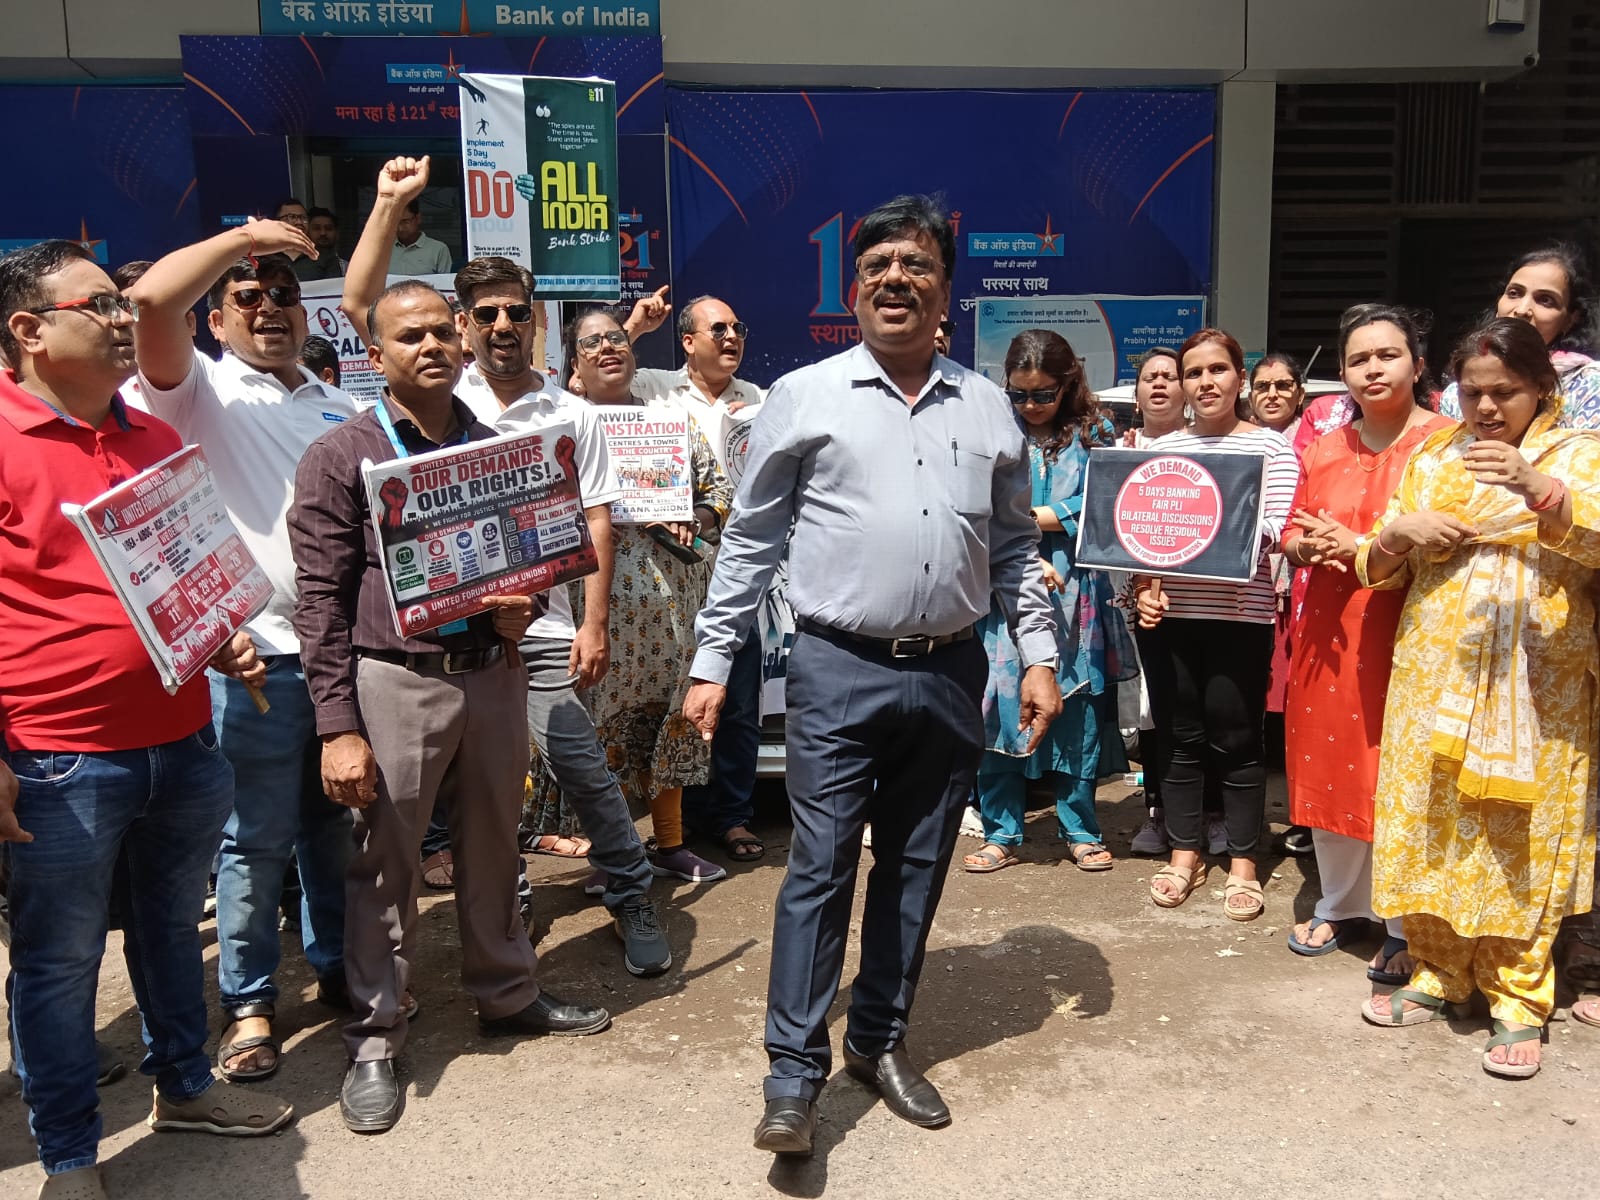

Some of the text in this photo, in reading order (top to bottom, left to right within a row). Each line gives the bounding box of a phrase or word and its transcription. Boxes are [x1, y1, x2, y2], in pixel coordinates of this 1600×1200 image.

[495, 4, 650, 27] Bank of India
[335, 105, 359, 120] मना
[361, 105, 383, 122] रहा
[386, 102, 397, 122] है
[467, 148, 488, 158] 5 Day
[467, 159, 497, 169] Banking
[541, 160, 608, 203] ALL
[542, 201, 609, 230] INDIA
[547, 230, 612, 250] Bank Strike
[982, 277, 1049, 291] परस्पर साथ
[1123, 337, 1147, 346] Probity
[622, 447, 636, 455] THE
[638, 446, 675, 455] COUNTRY
[653, 438, 679, 446] TOWNS
[420, 459, 445, 472] UNITED
[446, 456, 457, 465] WE
[484, 443, 506, 456] UNITED
[507, 440, 518, 450] WE
[411, 445, 544, 494] OUR DEMANDS
[1139, 460, 1203, 484] WE DEMAND
[417, 461, 552, 512] OUR RIGHTS!
[1138, 487, 1201, 499] 5 DAYS BANKING
[121, 499, 145, 526] UNITED
[432, 520, 443, 528] WE
[443, 516, 460, 526] FIGHT
[460, 512, 472, 520] FOR
[497, 497, 524, 508] FAIRNESS
[514, 506, 527, 514] OUR
[528, 500, 550, 511] STRIKE
[1152, 500, 1183, 511] FAIR PLI
[537, 513, 548, 522] ALL
[1121, 510, 1214, 526] BILATERAL DISCUSSIONS
[424, 522, 470, 542] OUR DEMANDS
[540, 529, 549, 537] ALL
[1130, 523, 1202, 538] RESOLVE RESIDUAL
[1125, 535, 1142, 556] UNITED
[1159, 555, 1166, 563] OF
[1149, 535, 1177, 547] ISSUES
[431, 566, 548, 611] UNITED FORUM OF BANK UNIONS
